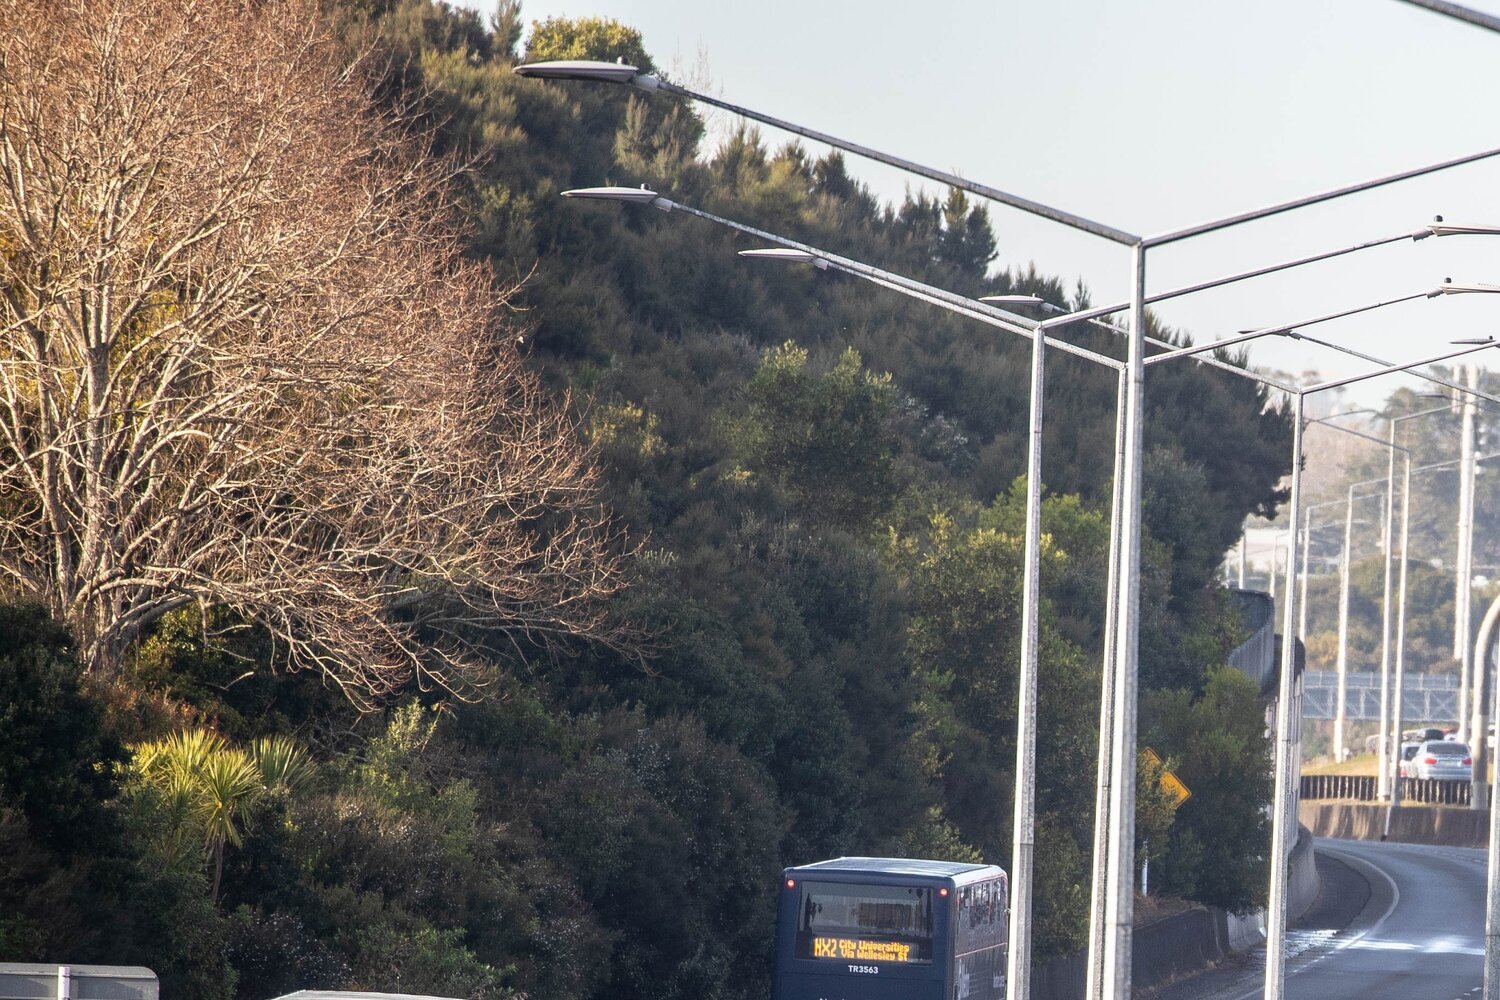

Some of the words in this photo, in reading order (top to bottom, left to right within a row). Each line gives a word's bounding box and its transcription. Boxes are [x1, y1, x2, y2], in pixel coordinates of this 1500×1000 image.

[813, 937, 837, 958] NX2
[838, 939, 857, 950] City
[858, 940, 910, 953] Universities
[841, 949, 855, 958] Via
[857, 949, 896, 961] Wellesley
[848, 964, 879, 974] TR3563
